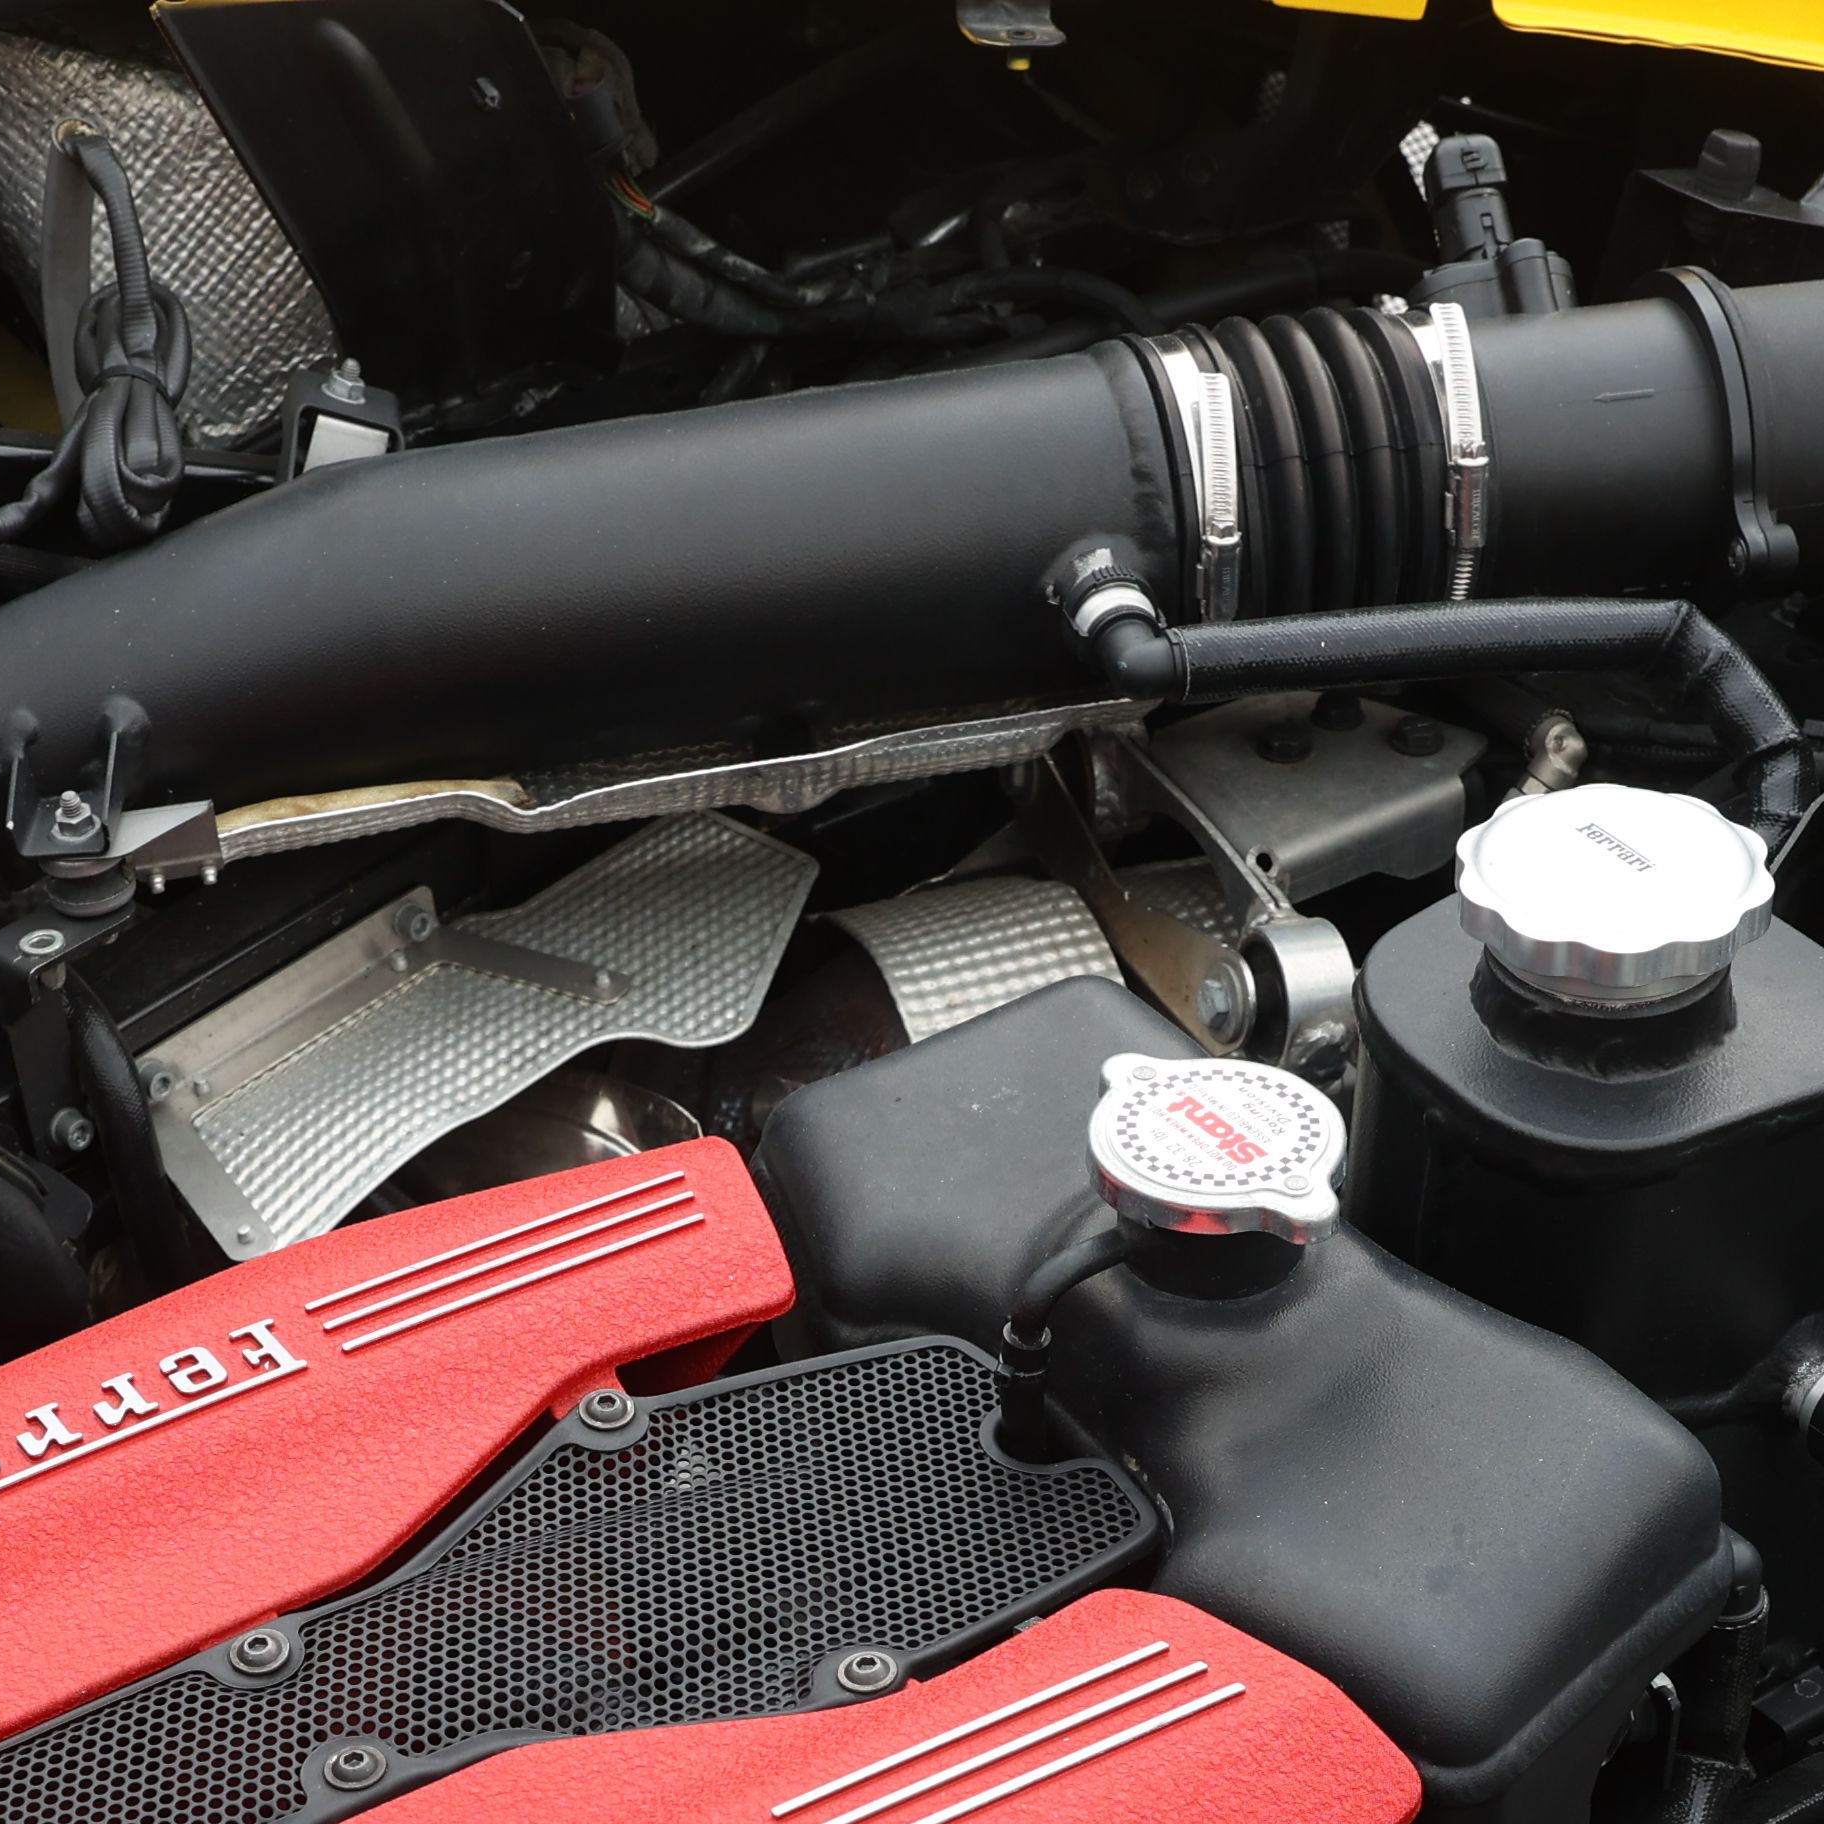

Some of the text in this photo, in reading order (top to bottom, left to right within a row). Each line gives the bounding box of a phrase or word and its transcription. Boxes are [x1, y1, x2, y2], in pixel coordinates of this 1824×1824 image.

[1575, 822, 1656, 872] Ferrari
[1239, 1087, 1292, 1125] Division
[1242, 1102, 1286, 1136] Racing
